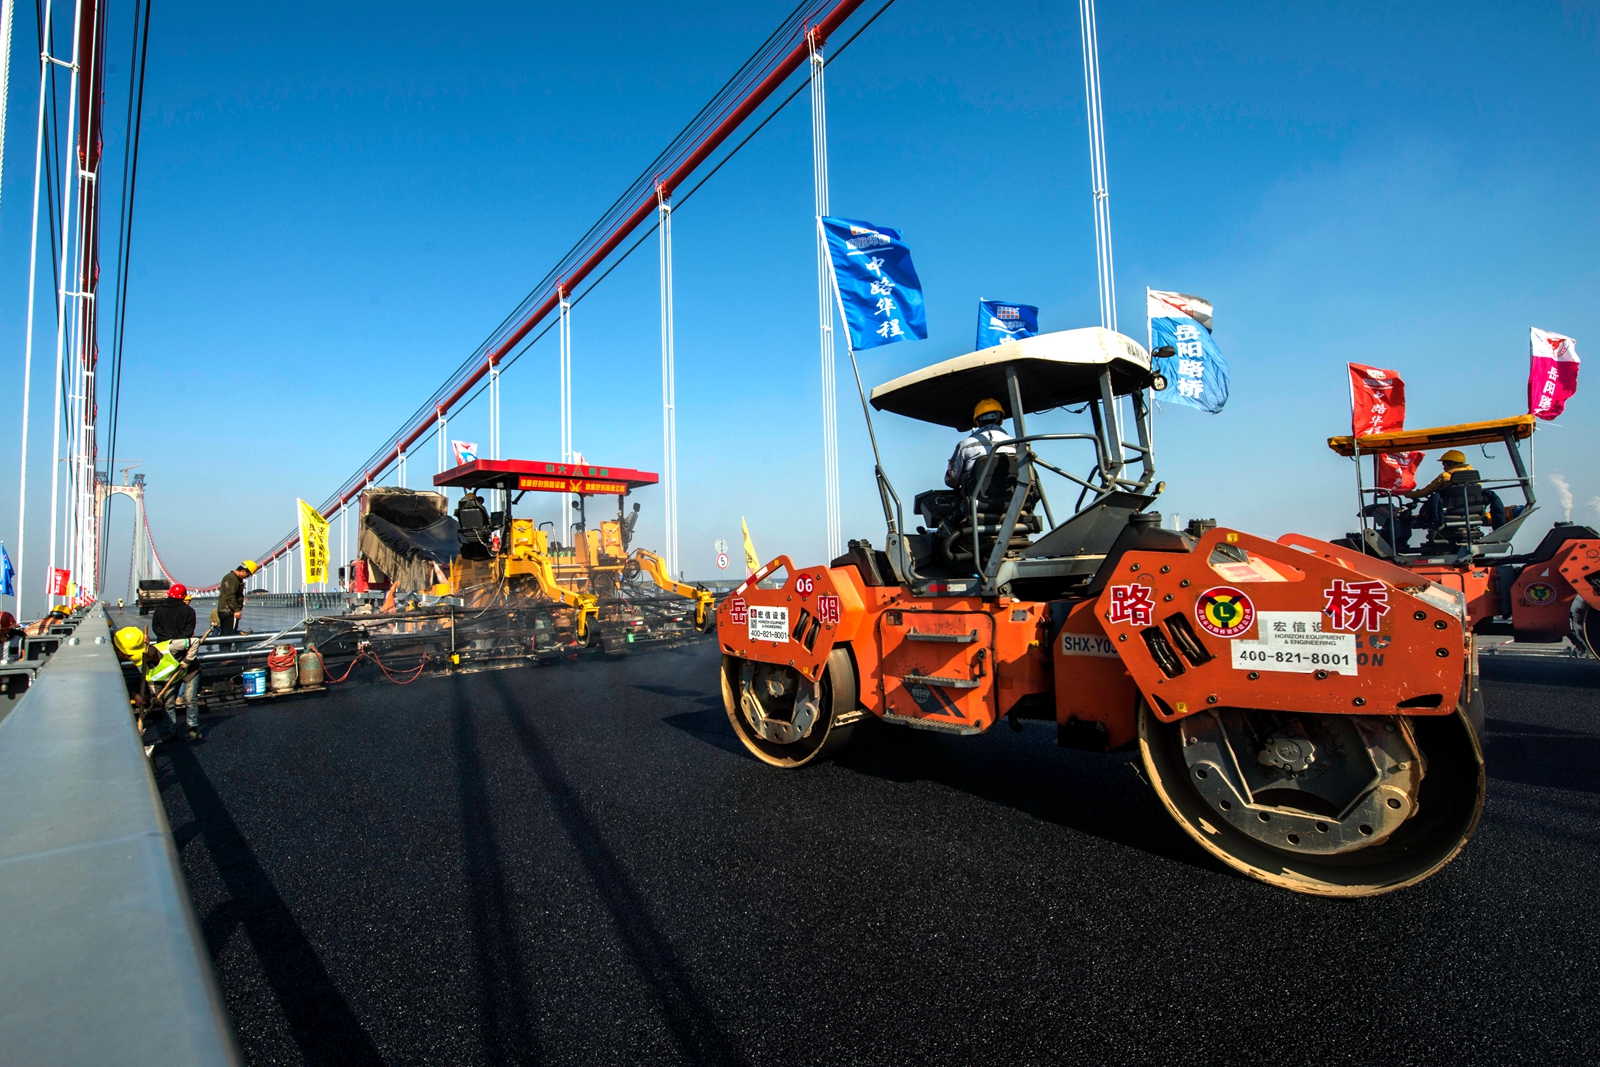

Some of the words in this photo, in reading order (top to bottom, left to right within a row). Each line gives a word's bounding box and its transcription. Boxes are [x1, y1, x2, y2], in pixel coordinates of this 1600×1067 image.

[865, 256, 905, 338] 中路华程
[1173, 324, 1204, 399] 岳阳路桥
[720, 556, 726, 566] 5
[796, 578, 813, 592] 06
[730, 598, 748, 624] 岳
[818, 596, 840, 623] 阳
[1110, 583, 1155, 626] 路
[1324, 579, 1391, 632] 桥
[1219, 605, 1230, 617] L
[758, 610, 786, 620] 宏信设备
[751, 630, 787, 639] 400-821-8001
[1240, 650, 1349, 666] 400-821-8001
